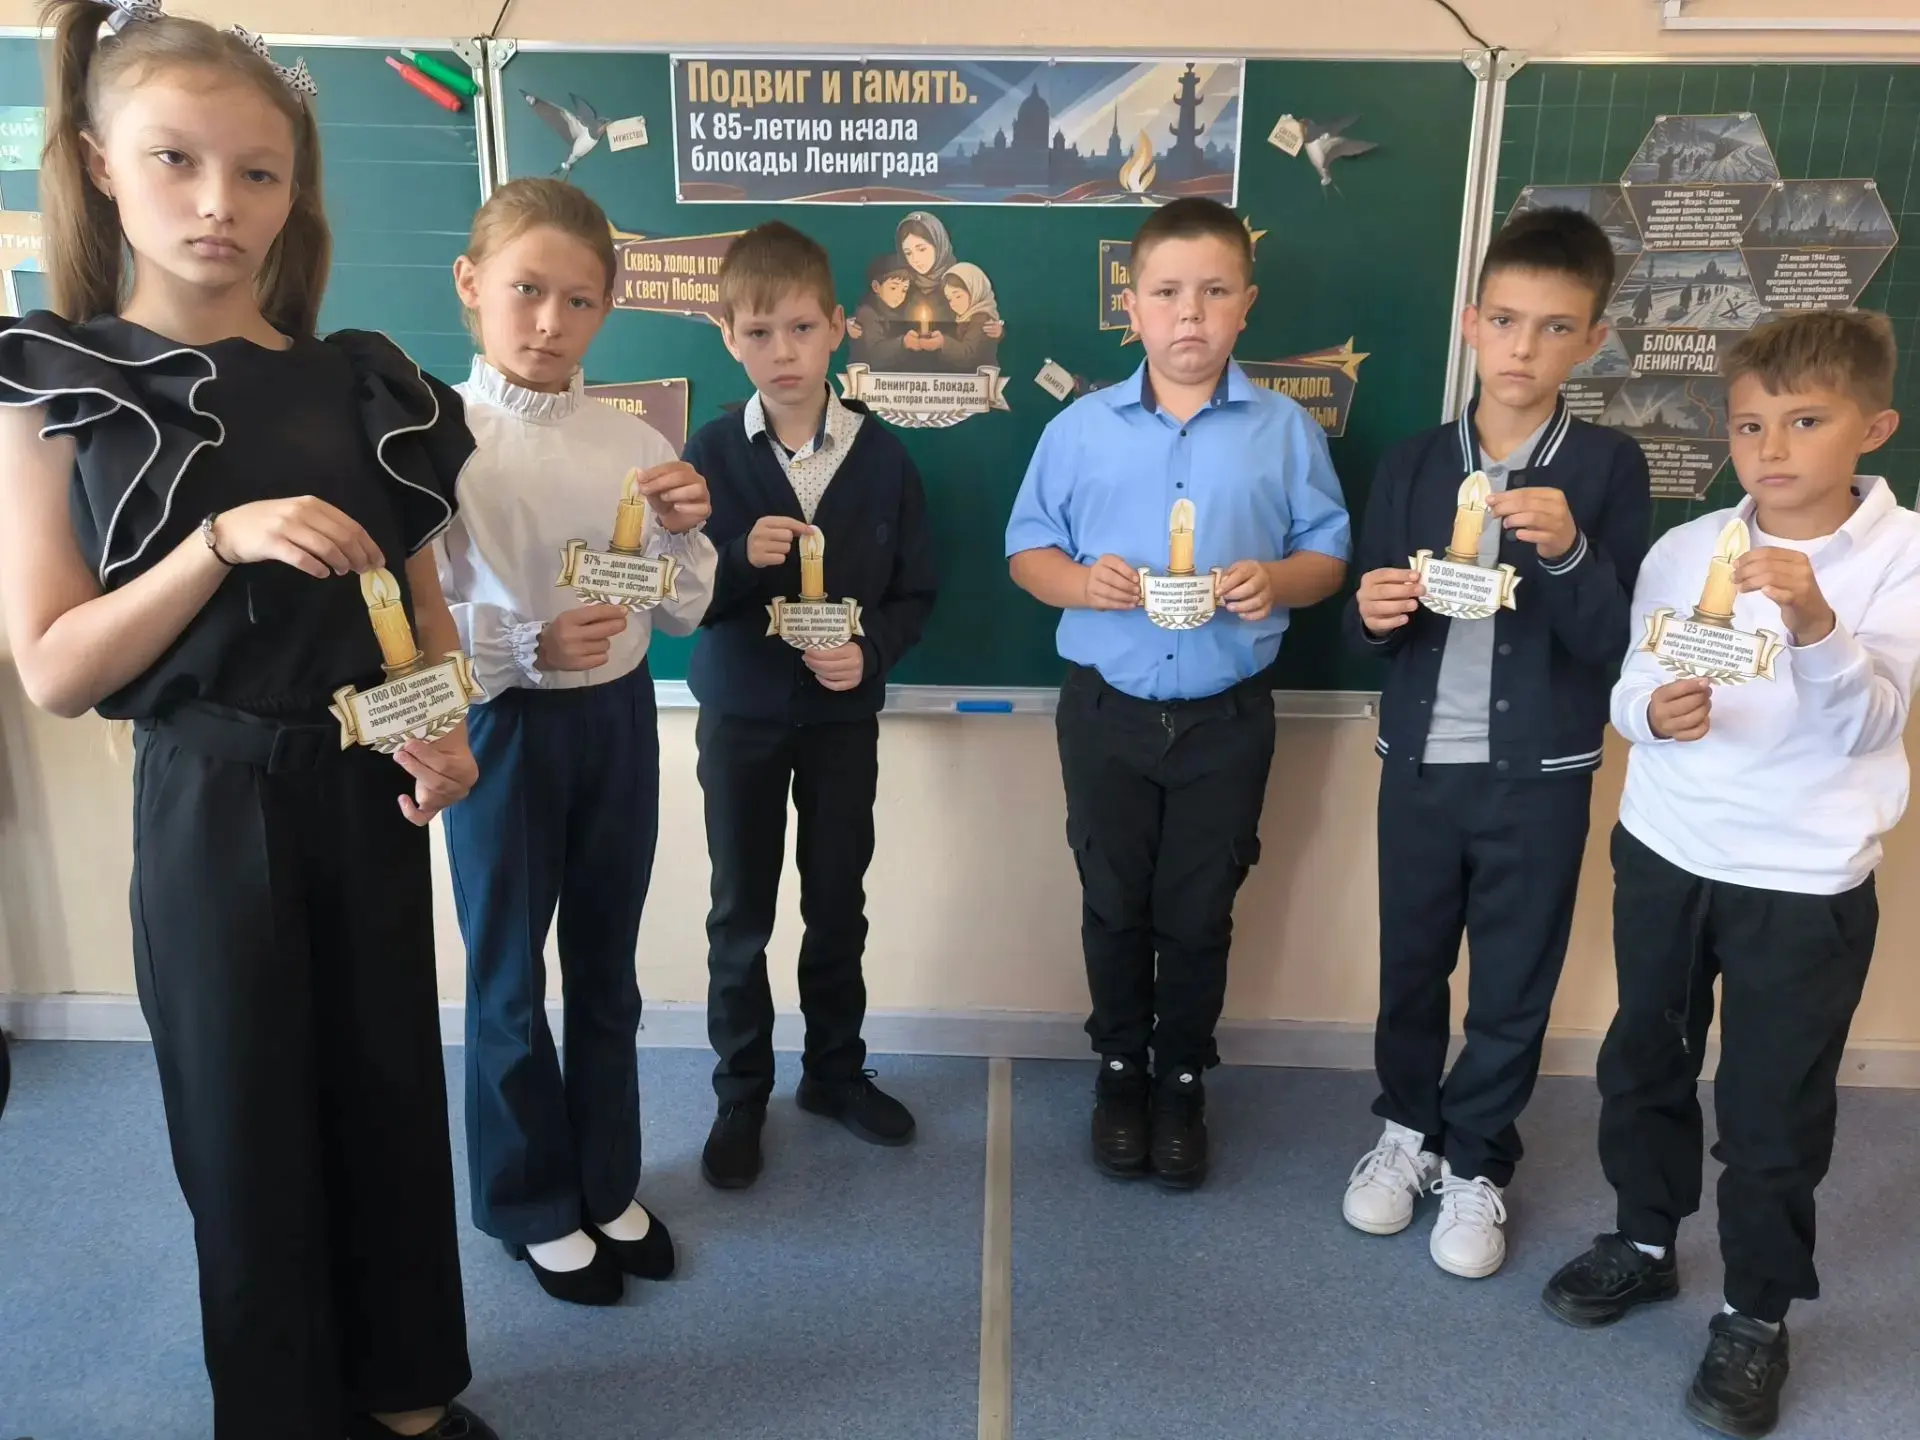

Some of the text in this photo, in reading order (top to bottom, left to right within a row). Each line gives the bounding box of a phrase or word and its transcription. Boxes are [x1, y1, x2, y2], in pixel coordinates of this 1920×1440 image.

[688, 62, 810, 108] Подвиг
[822, 71, 840, 103] и
[690, 112, 704, 140] К
[713, 112, 832, 140] 85-летию
[613, 130, 643, 142] МУЖЕСТВО
[692, 146, 797, 176] блокады
[624, 248, 662, 272] Сквозь
[664, 255, 696, 275] холод
[698, 256, 704, 274] и
[626, 278, 719, 304] к свету Победы
[1643, 334, 1716, 353] БЛОКАДА
[874, 379, 978, 395] Ленинград. Блокада.
[862, 393, 891, 405] Память,
[894, 395, 923, 406] которая
[924, 395, 954, 404] сильнее
[584, 554, 658, 573] 97% доля погибших
[578, 575, 590, 585] (3%
[592, 579, 609, 587] жертв
[599, 569, 620, 579] голода
[627, 573, 648, 582] холода
[1429, 565, 1485, 582] 150 000 снарядов
[1155, 580, 1160, 588] 14
[1428, 577, 1460, 588] выпущено
[1470, 584, 1492, 595] городу
[1438, 588, 1457, 597] время
[1459, 591, 1487, 603] блокады
[1683, 624, 1733, 641] 125 граммов
[1662, 640, 1679, 648] хлеба
[1680, 642, 1692, 651] для
[1693, 644, 1729, 658] иждивенцев
[1734, 654, 1752, 663] детей
[1666, 632, 1753, 655] минимальная суточная норма
[1675, 651, 1695, 660] самую
[1724, 661, 1740, 670] зиму
[365, 674, 437, 706] 1 000 000 человек
[368, 683, 449, 717] столько людей удалось
[370, 706, 418, 728] эвакуировать
[419, 701, 427, 709] по
